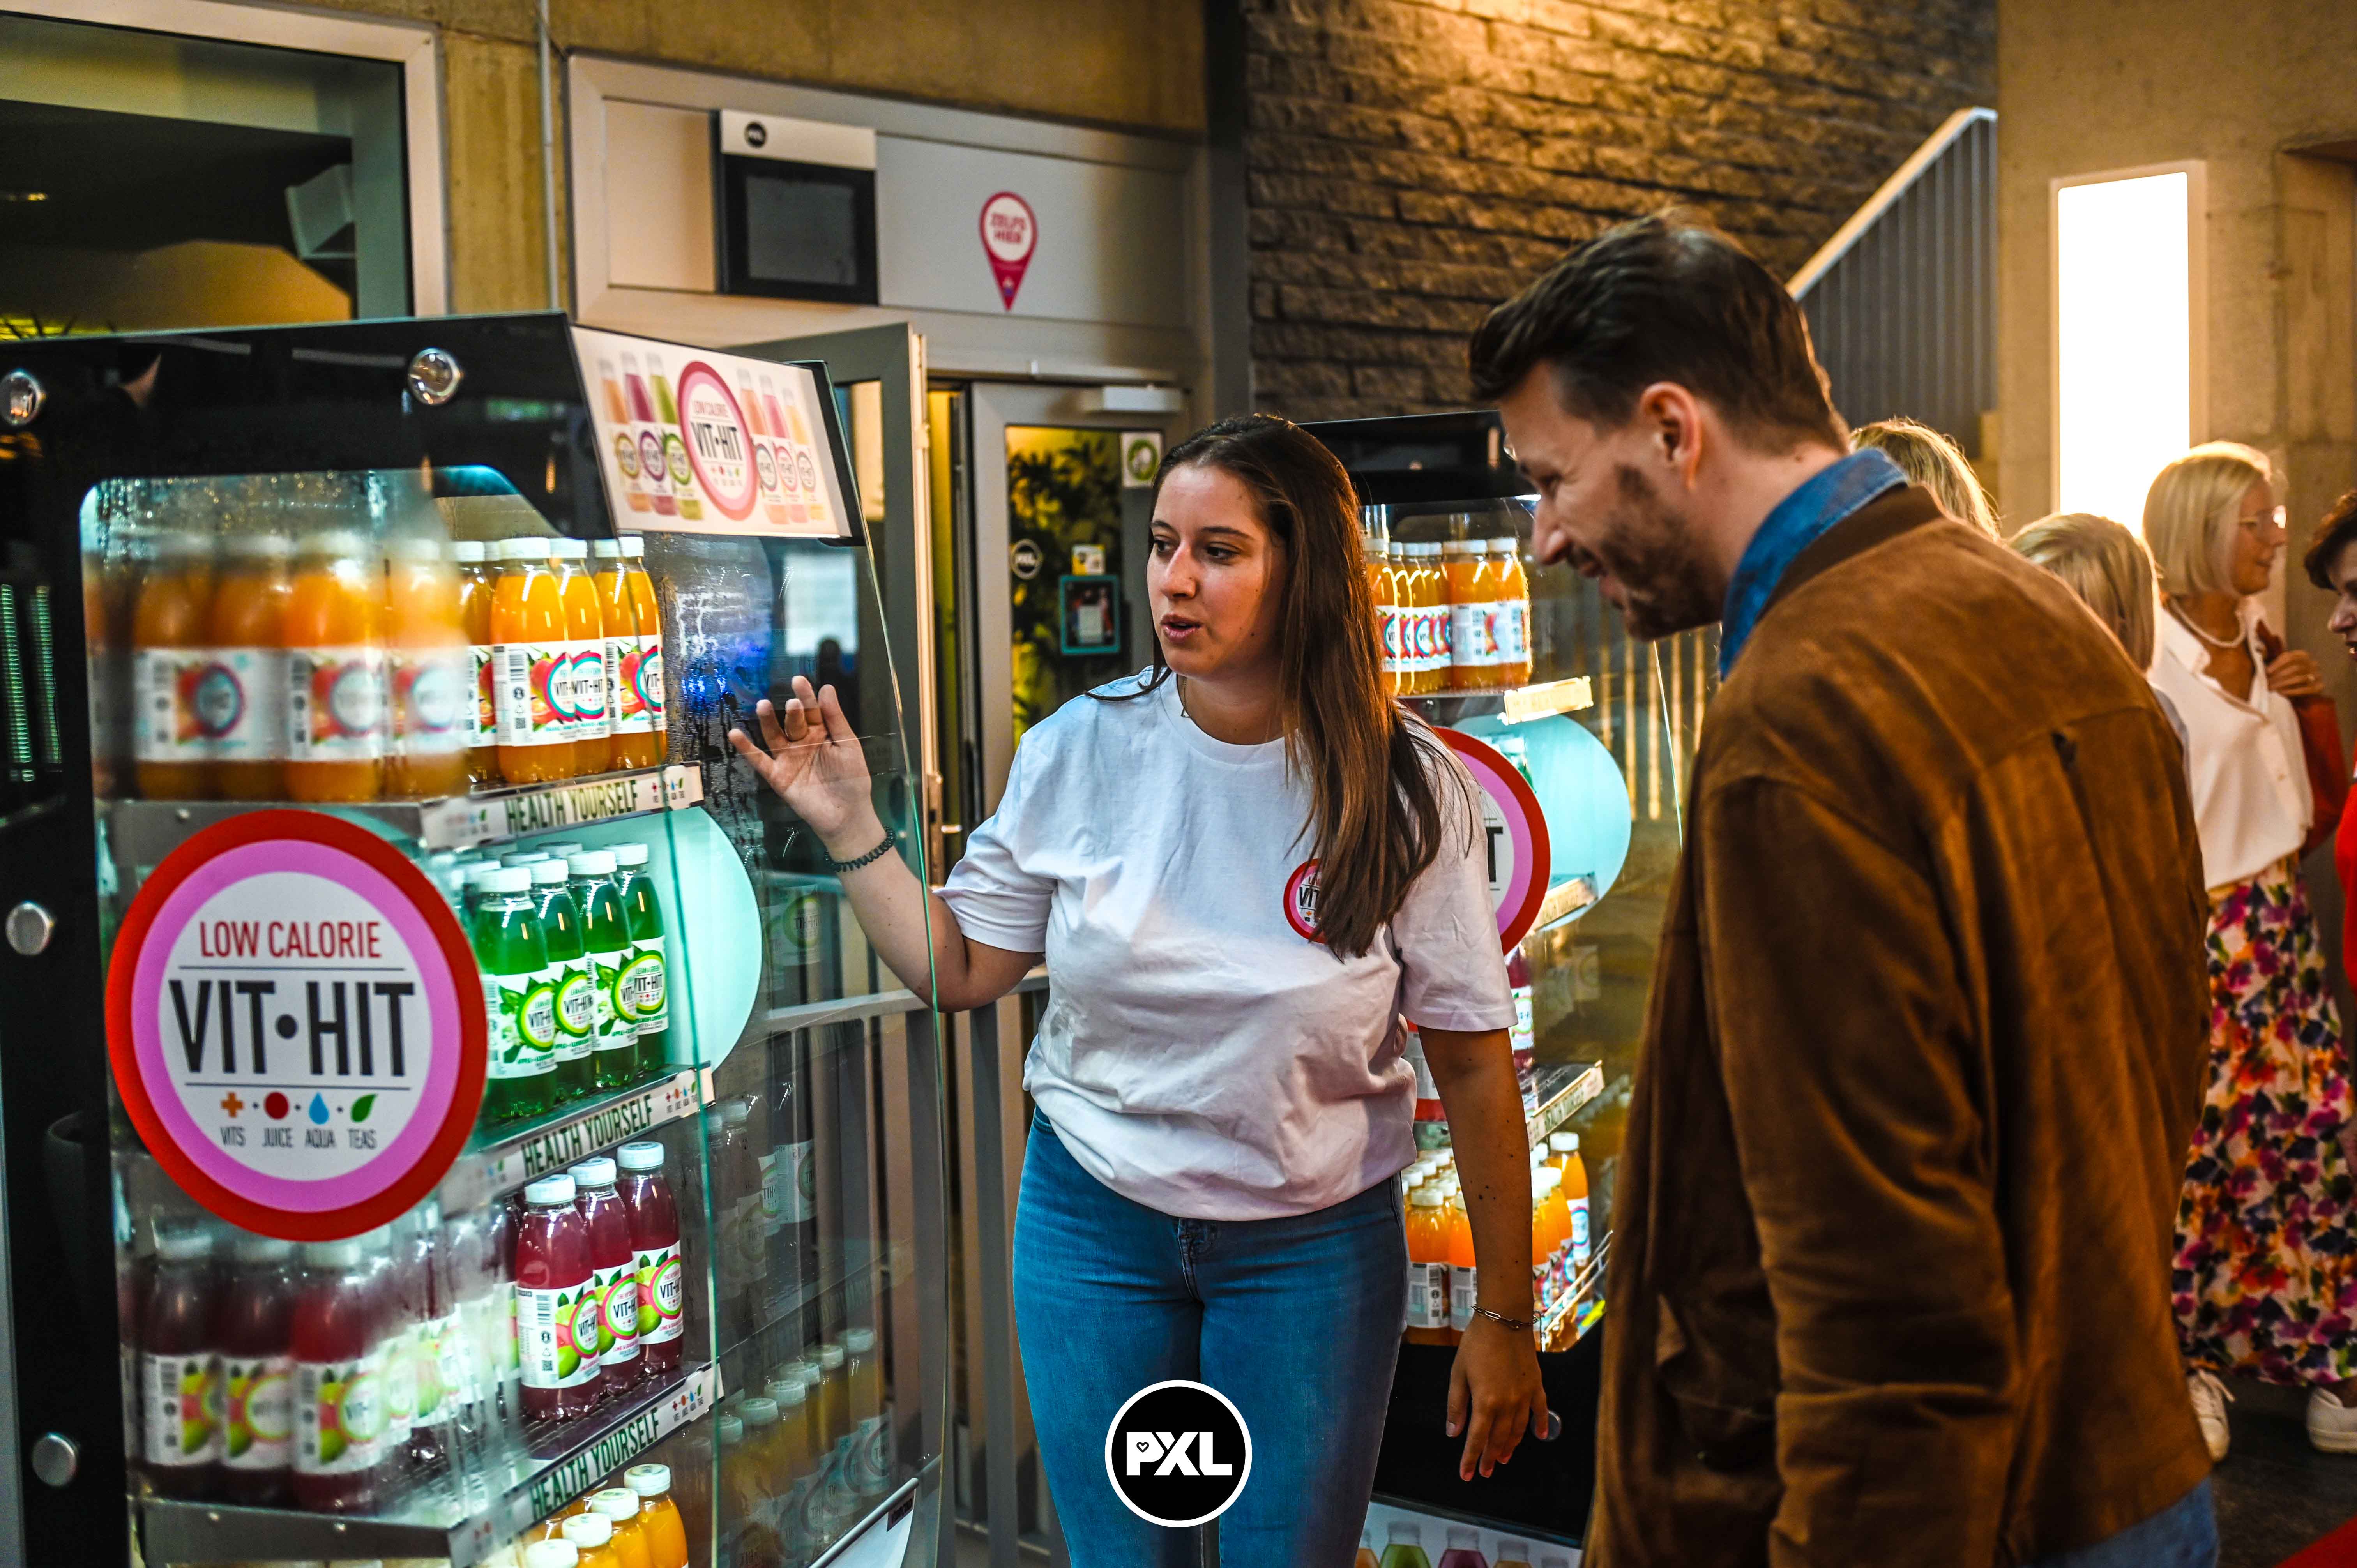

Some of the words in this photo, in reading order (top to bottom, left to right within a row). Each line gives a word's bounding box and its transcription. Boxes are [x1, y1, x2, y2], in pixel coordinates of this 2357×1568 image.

[506, 791, 566, 834] HEALTH
[567, 780, 637, 821] YOURSELF
[199, 921, 260, 957] LOW
[268, 921, 381, 958] CALORIE
[220, 1126, 246, 1146] VITS
[262, 1127, 292, 1148] JUICE
[305, 1128, 335, 1148] AQUA
[349, 1129, 377, 1150] TEAS
[521, 1122, 581, 1176] HEALTH
[584, 1094, 653, 1152] YOURSELF
[530, 1453, 589, 1519] HEALTH
[590, 1407, 659, 1478] YOURSELF
